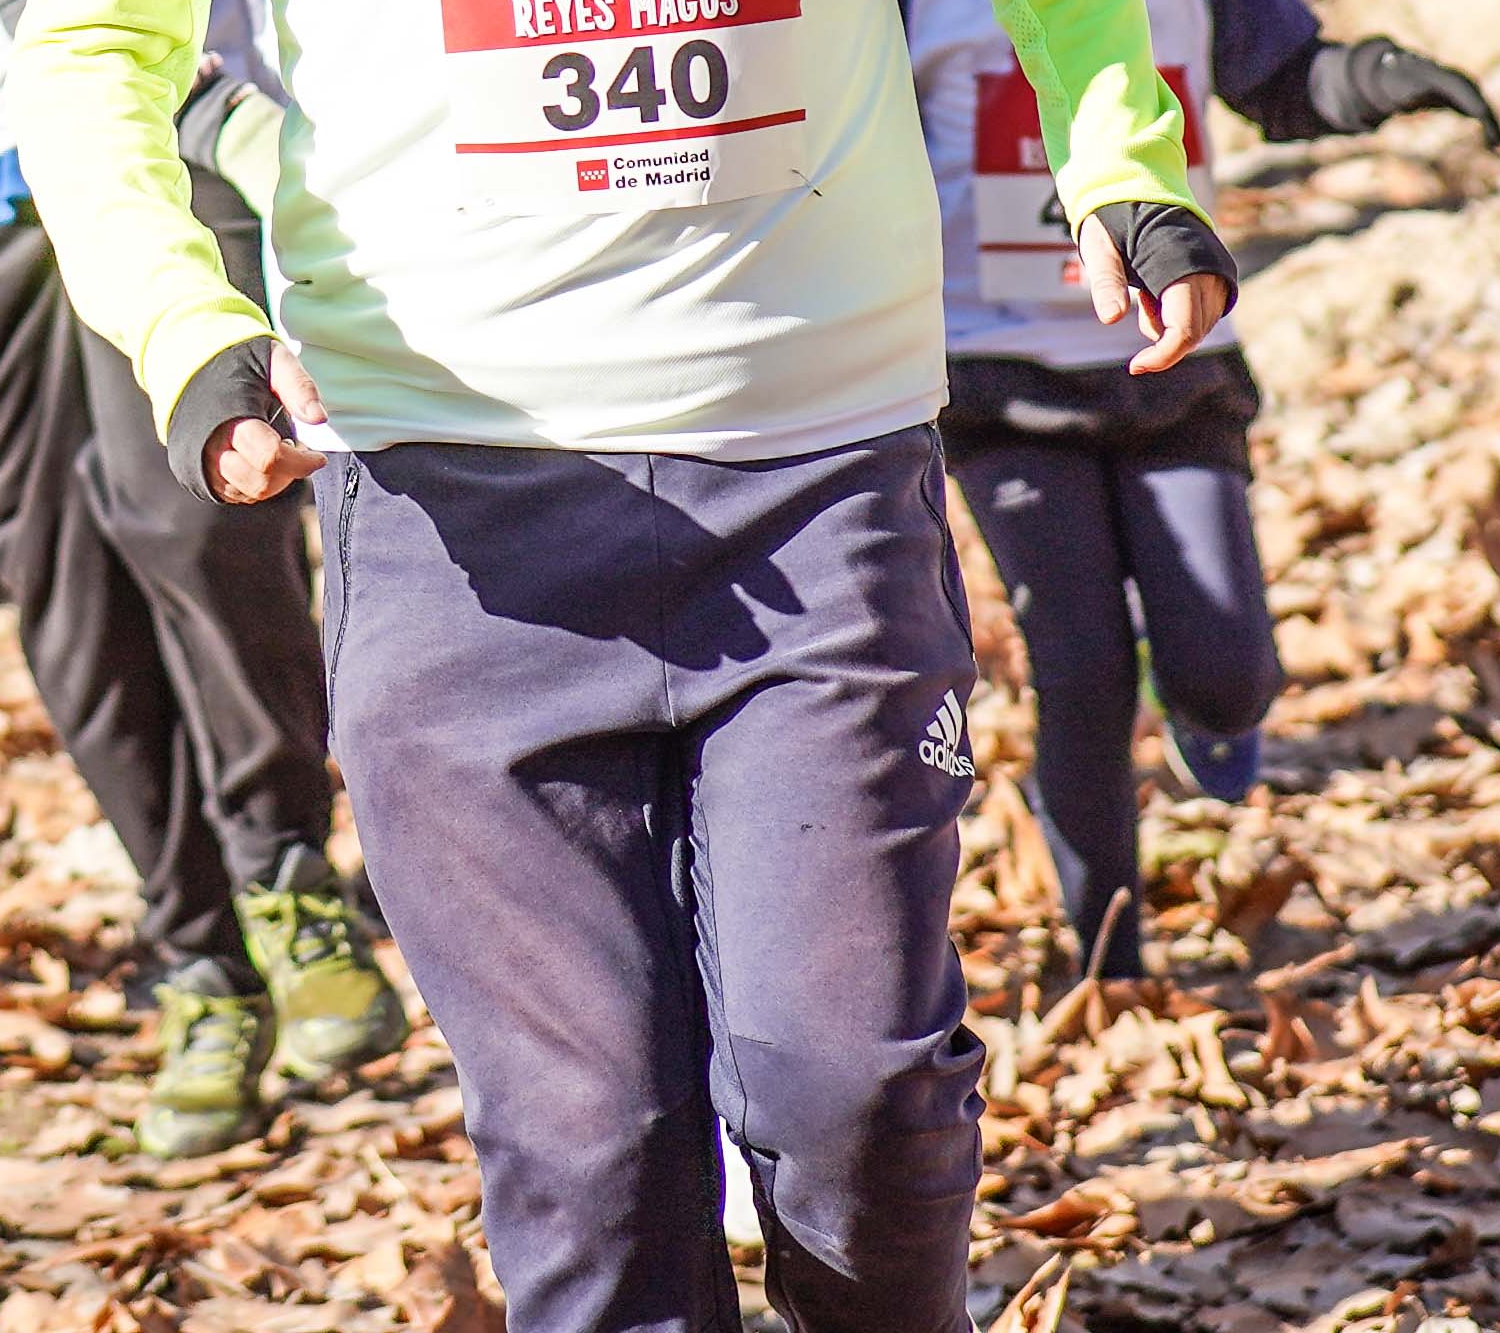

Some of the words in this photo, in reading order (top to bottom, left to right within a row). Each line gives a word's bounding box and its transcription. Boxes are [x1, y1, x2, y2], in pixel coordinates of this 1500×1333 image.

[542, 39, 730, 131] 340
[613, 149, 709, 170] Comunidad
[615, 177, 638, 189] de
[645, 168, 711, 187] Madrid
